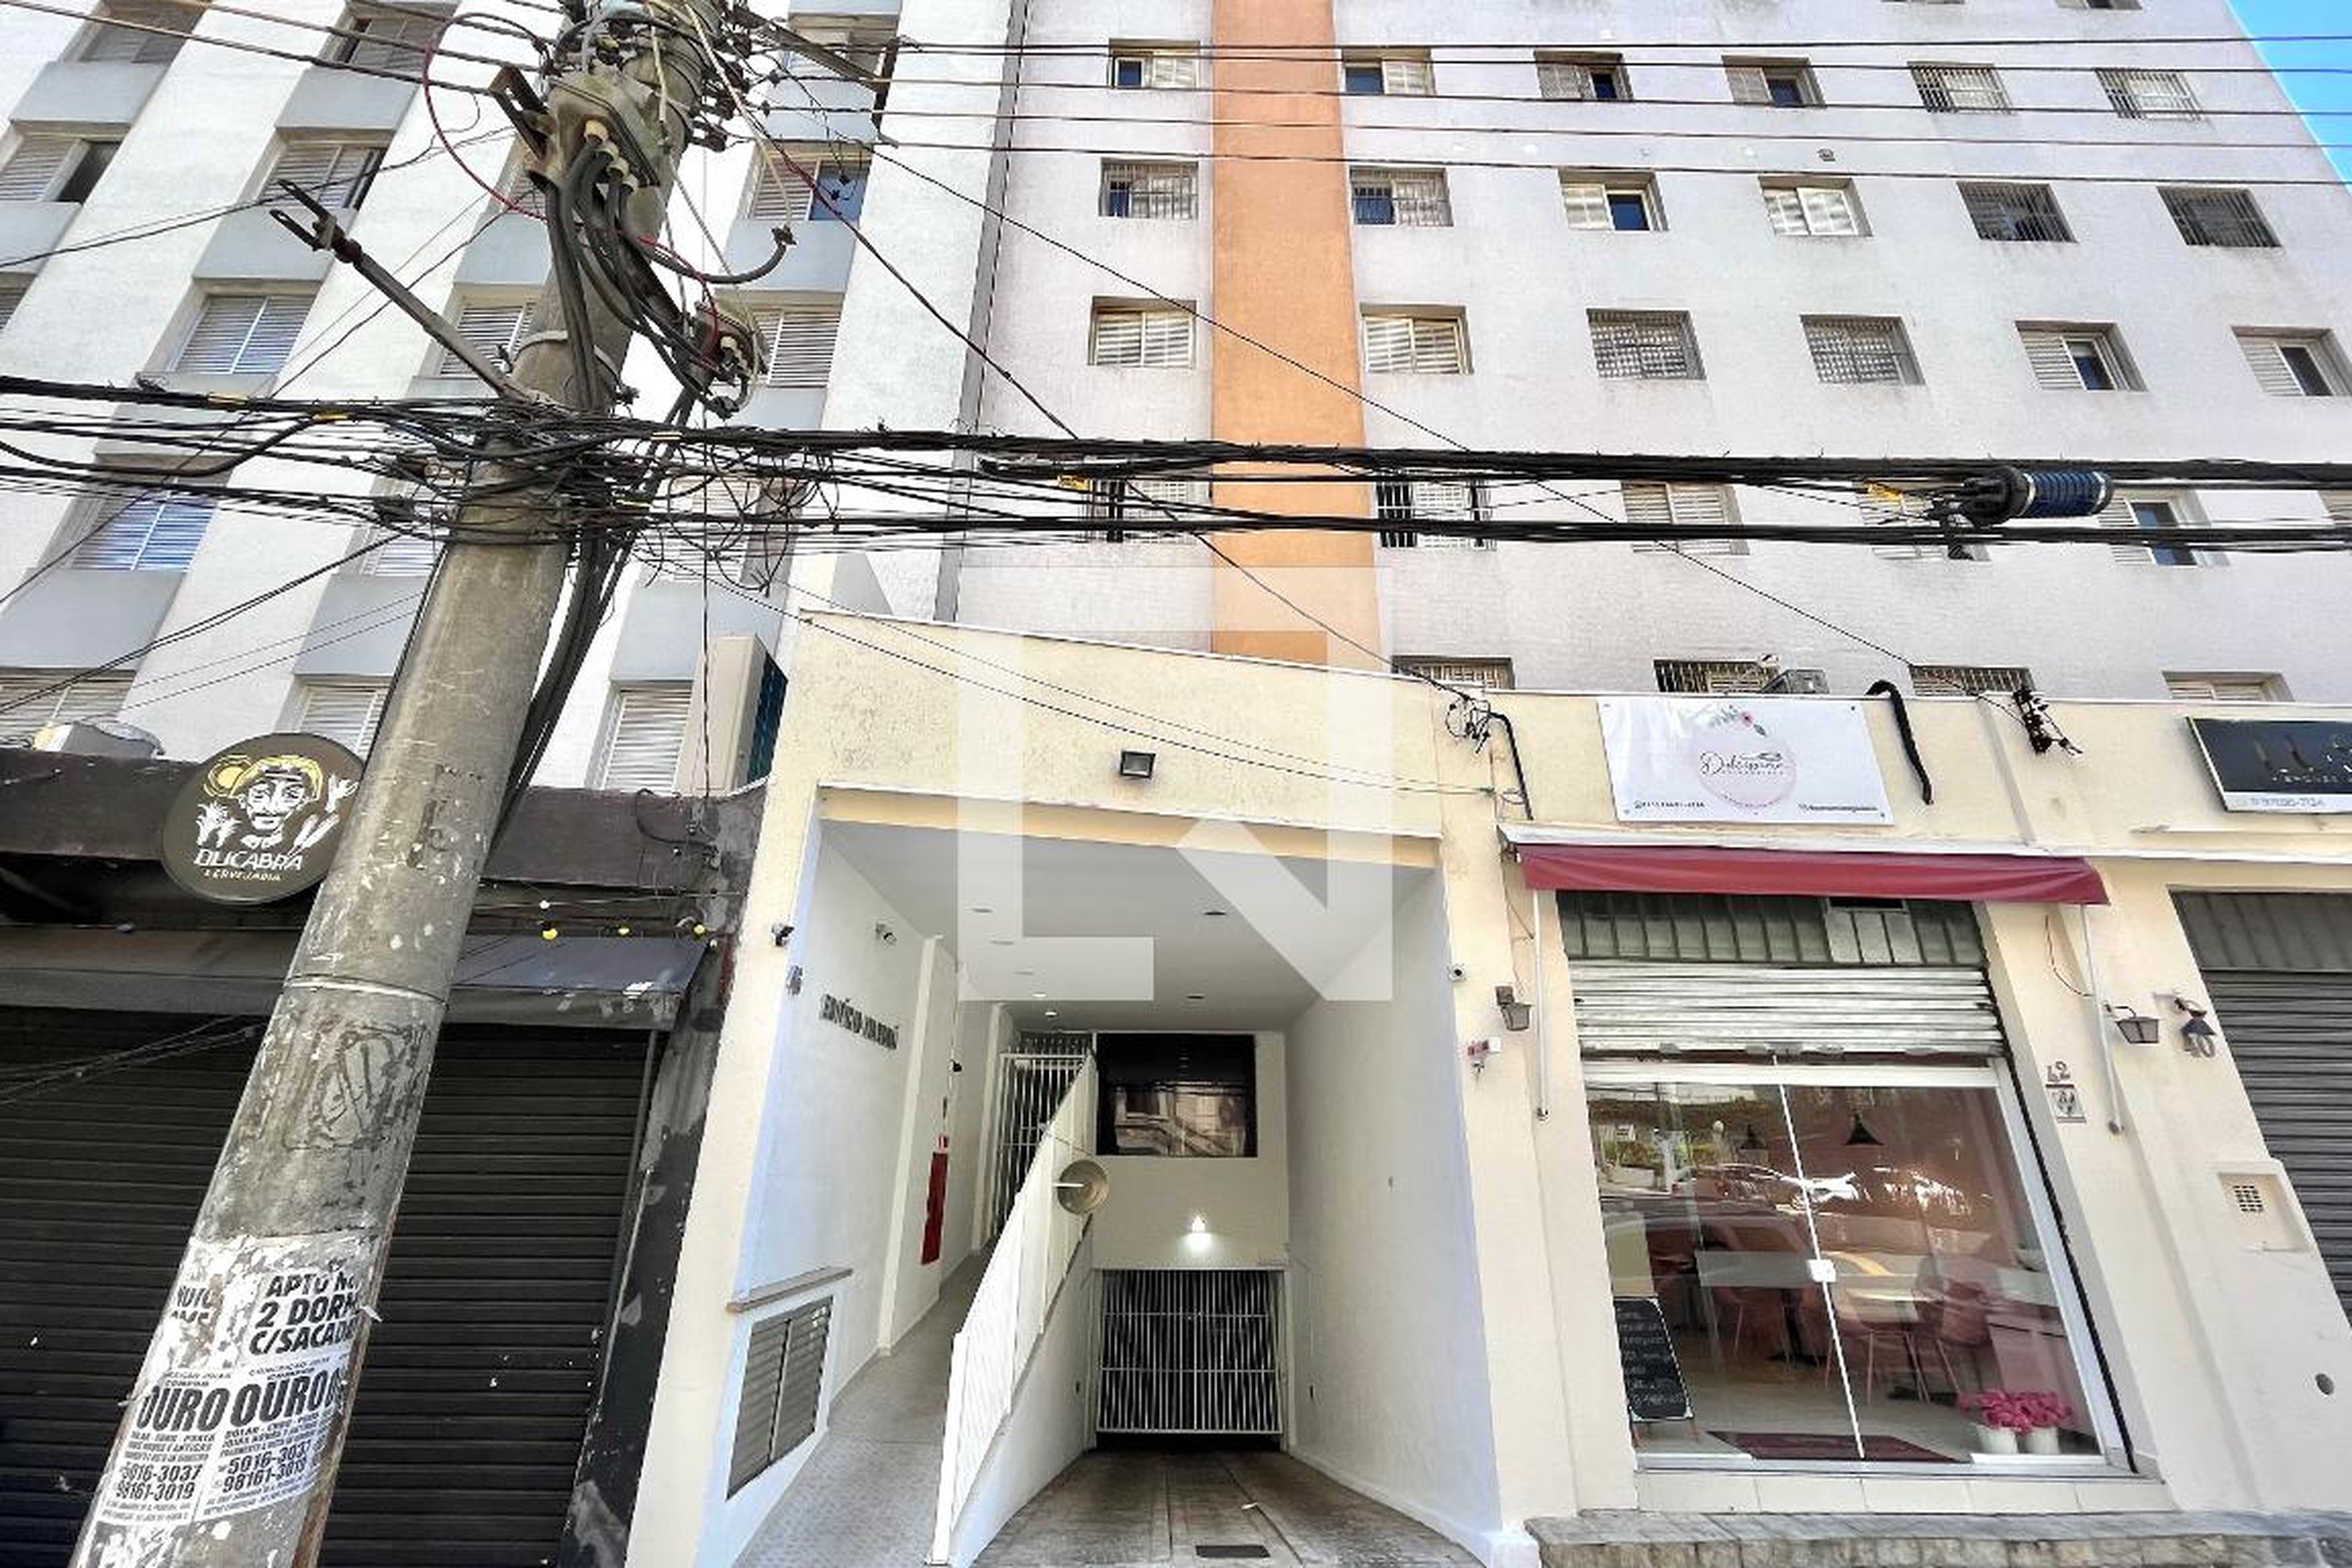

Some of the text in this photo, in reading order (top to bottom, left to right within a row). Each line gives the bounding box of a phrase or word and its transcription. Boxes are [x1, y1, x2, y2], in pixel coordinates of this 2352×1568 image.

[255, 1302, 280, 1329] 2
[136, 1385, 230, 1431] OURO
[230, 1370, 329, 1427] OURO
